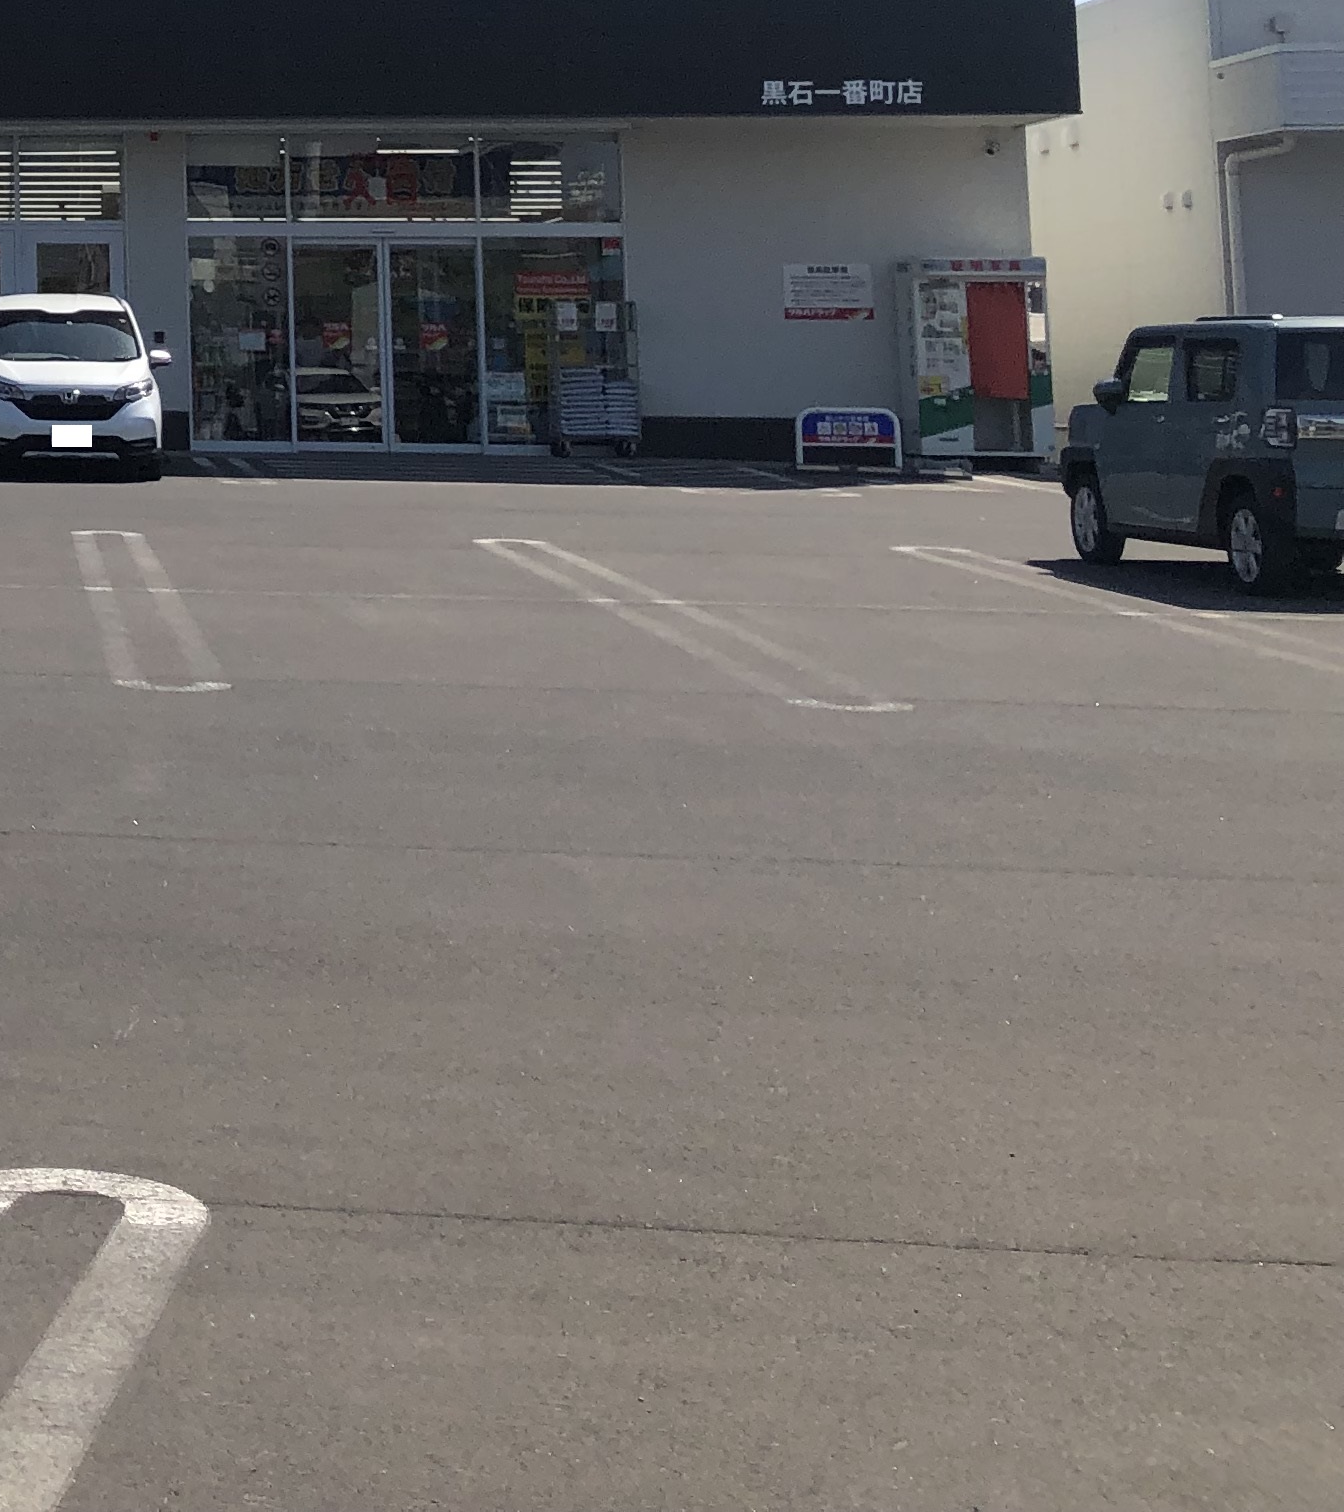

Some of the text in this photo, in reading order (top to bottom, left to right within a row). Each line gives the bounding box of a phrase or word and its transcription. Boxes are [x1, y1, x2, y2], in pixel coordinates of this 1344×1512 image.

[761, 79, 923, 106] 黒石一番町店
